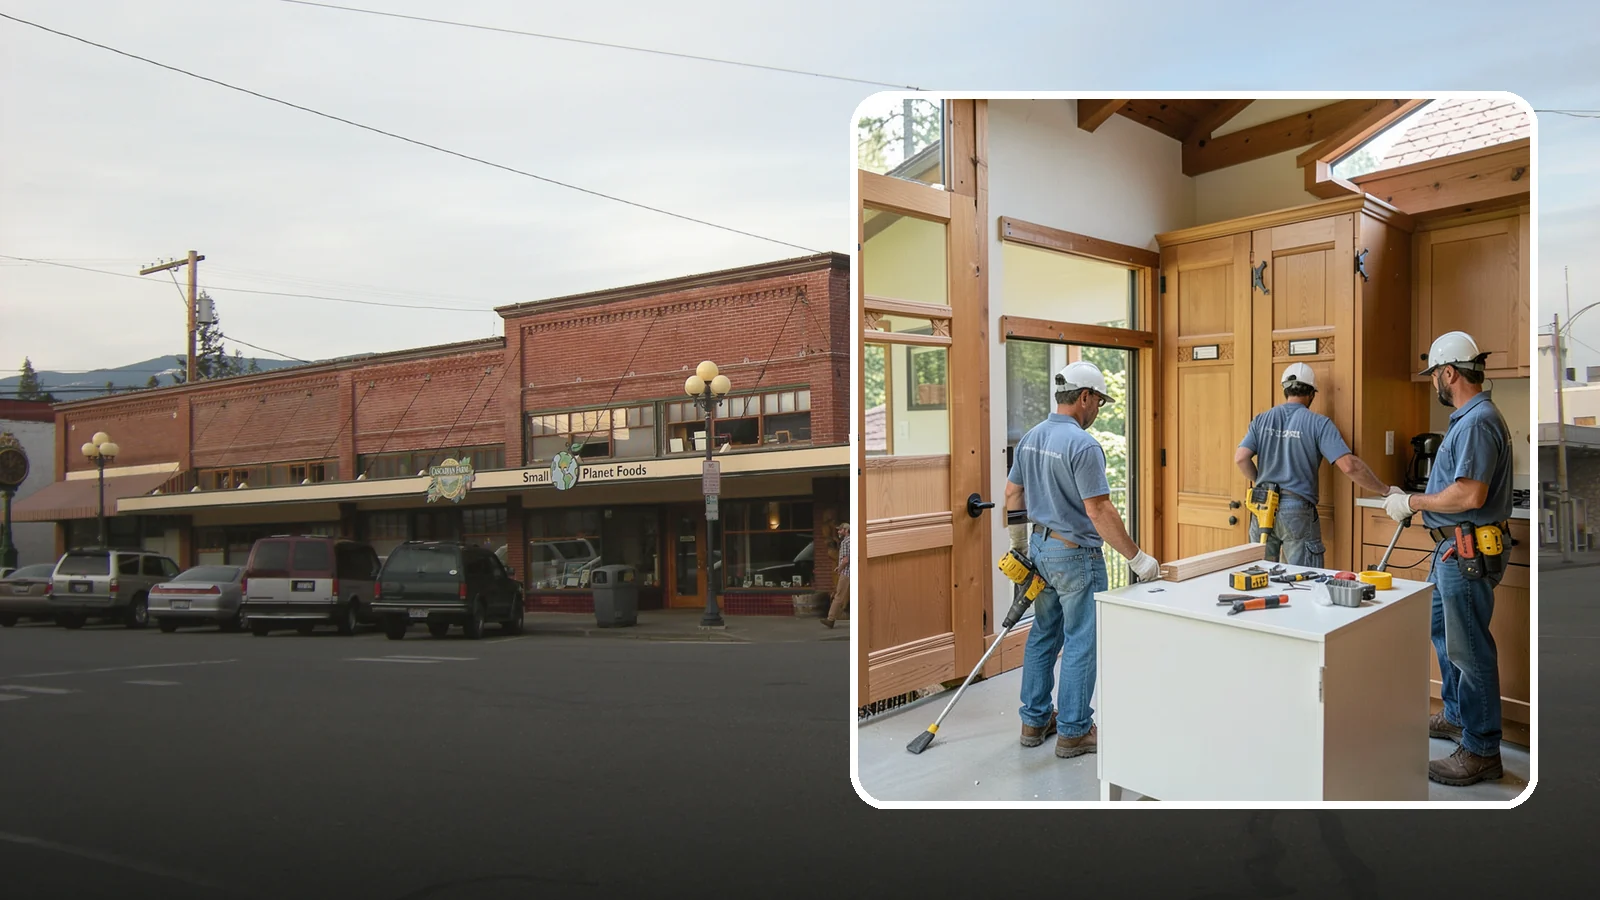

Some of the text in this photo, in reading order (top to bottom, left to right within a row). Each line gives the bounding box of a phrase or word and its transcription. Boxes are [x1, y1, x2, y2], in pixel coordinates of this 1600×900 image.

[523, 464, 647, 483] Small Planet Foods
